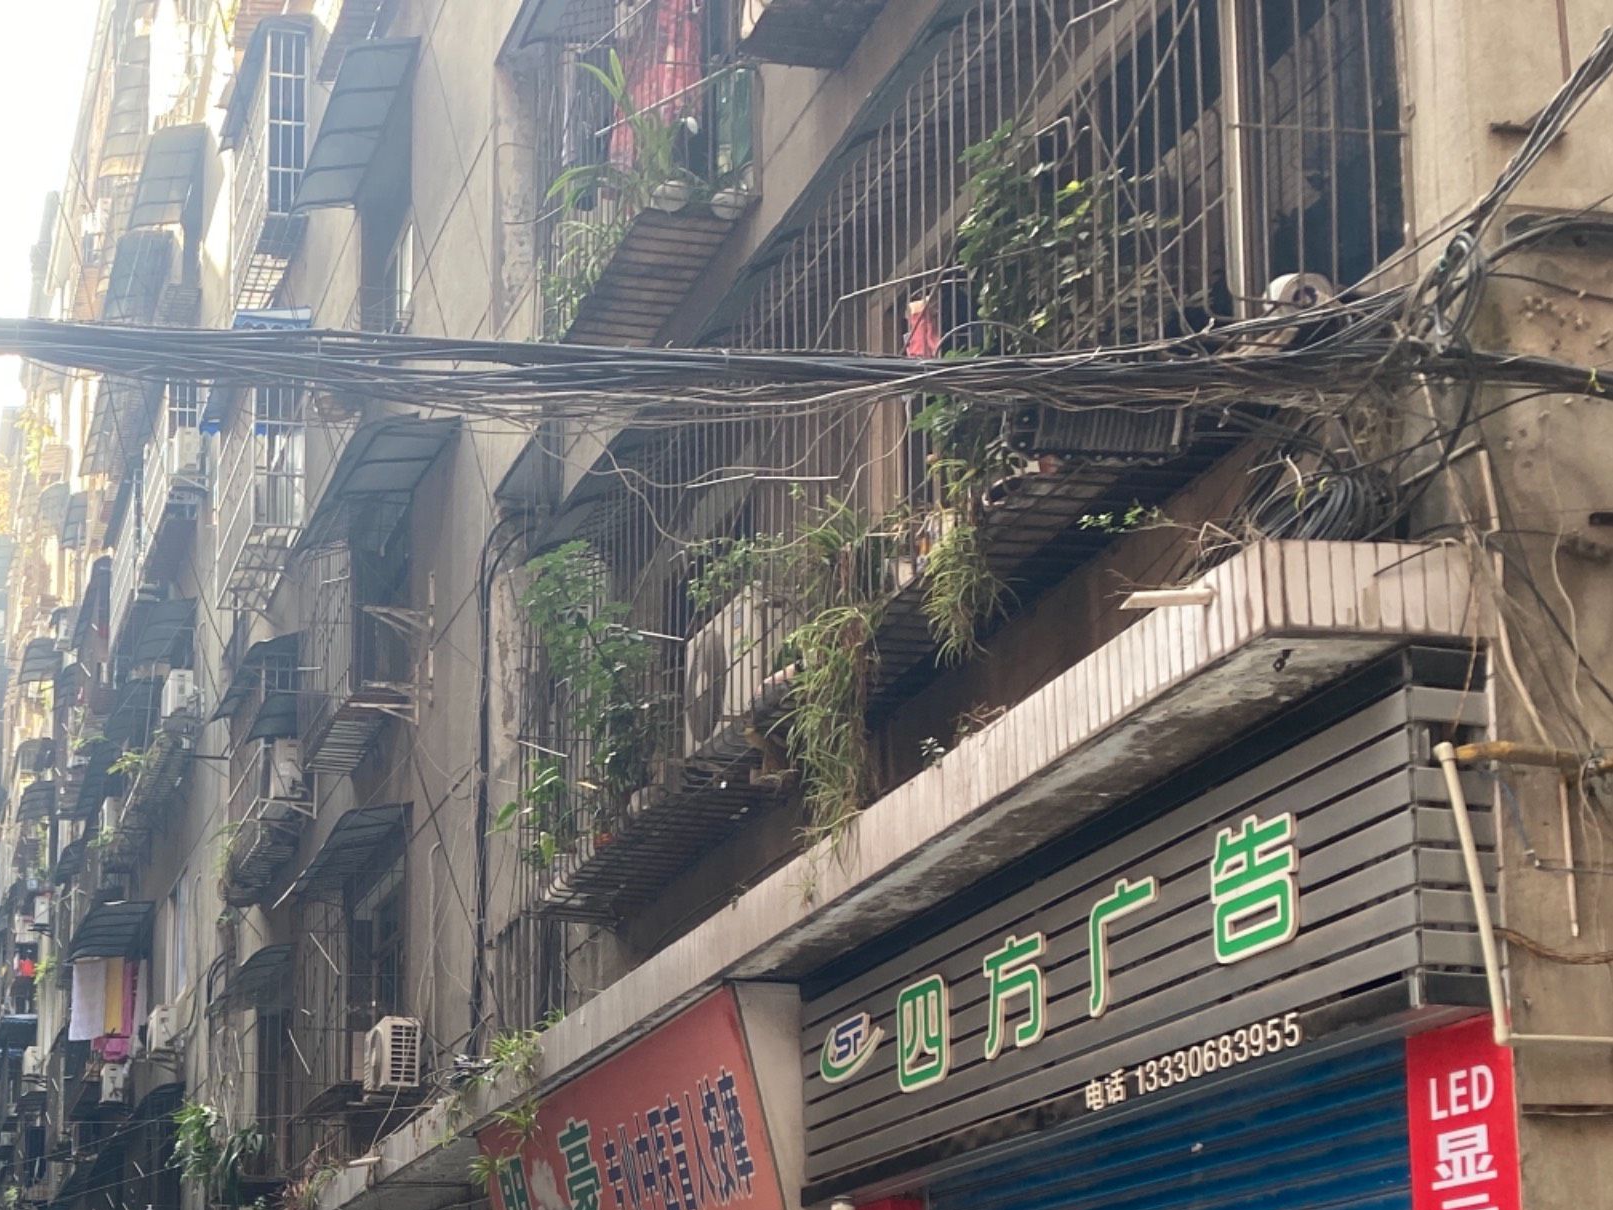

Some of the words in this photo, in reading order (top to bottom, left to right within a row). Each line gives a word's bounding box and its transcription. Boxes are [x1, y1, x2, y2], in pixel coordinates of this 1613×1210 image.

[896, 811, 1300, 1093] 四方广告
[1084, 1069, 1127, 1112] 电话
[1134, 1012, 1303, 1096] 13330683955
[1428, 1064, 1495, 1122] LED
